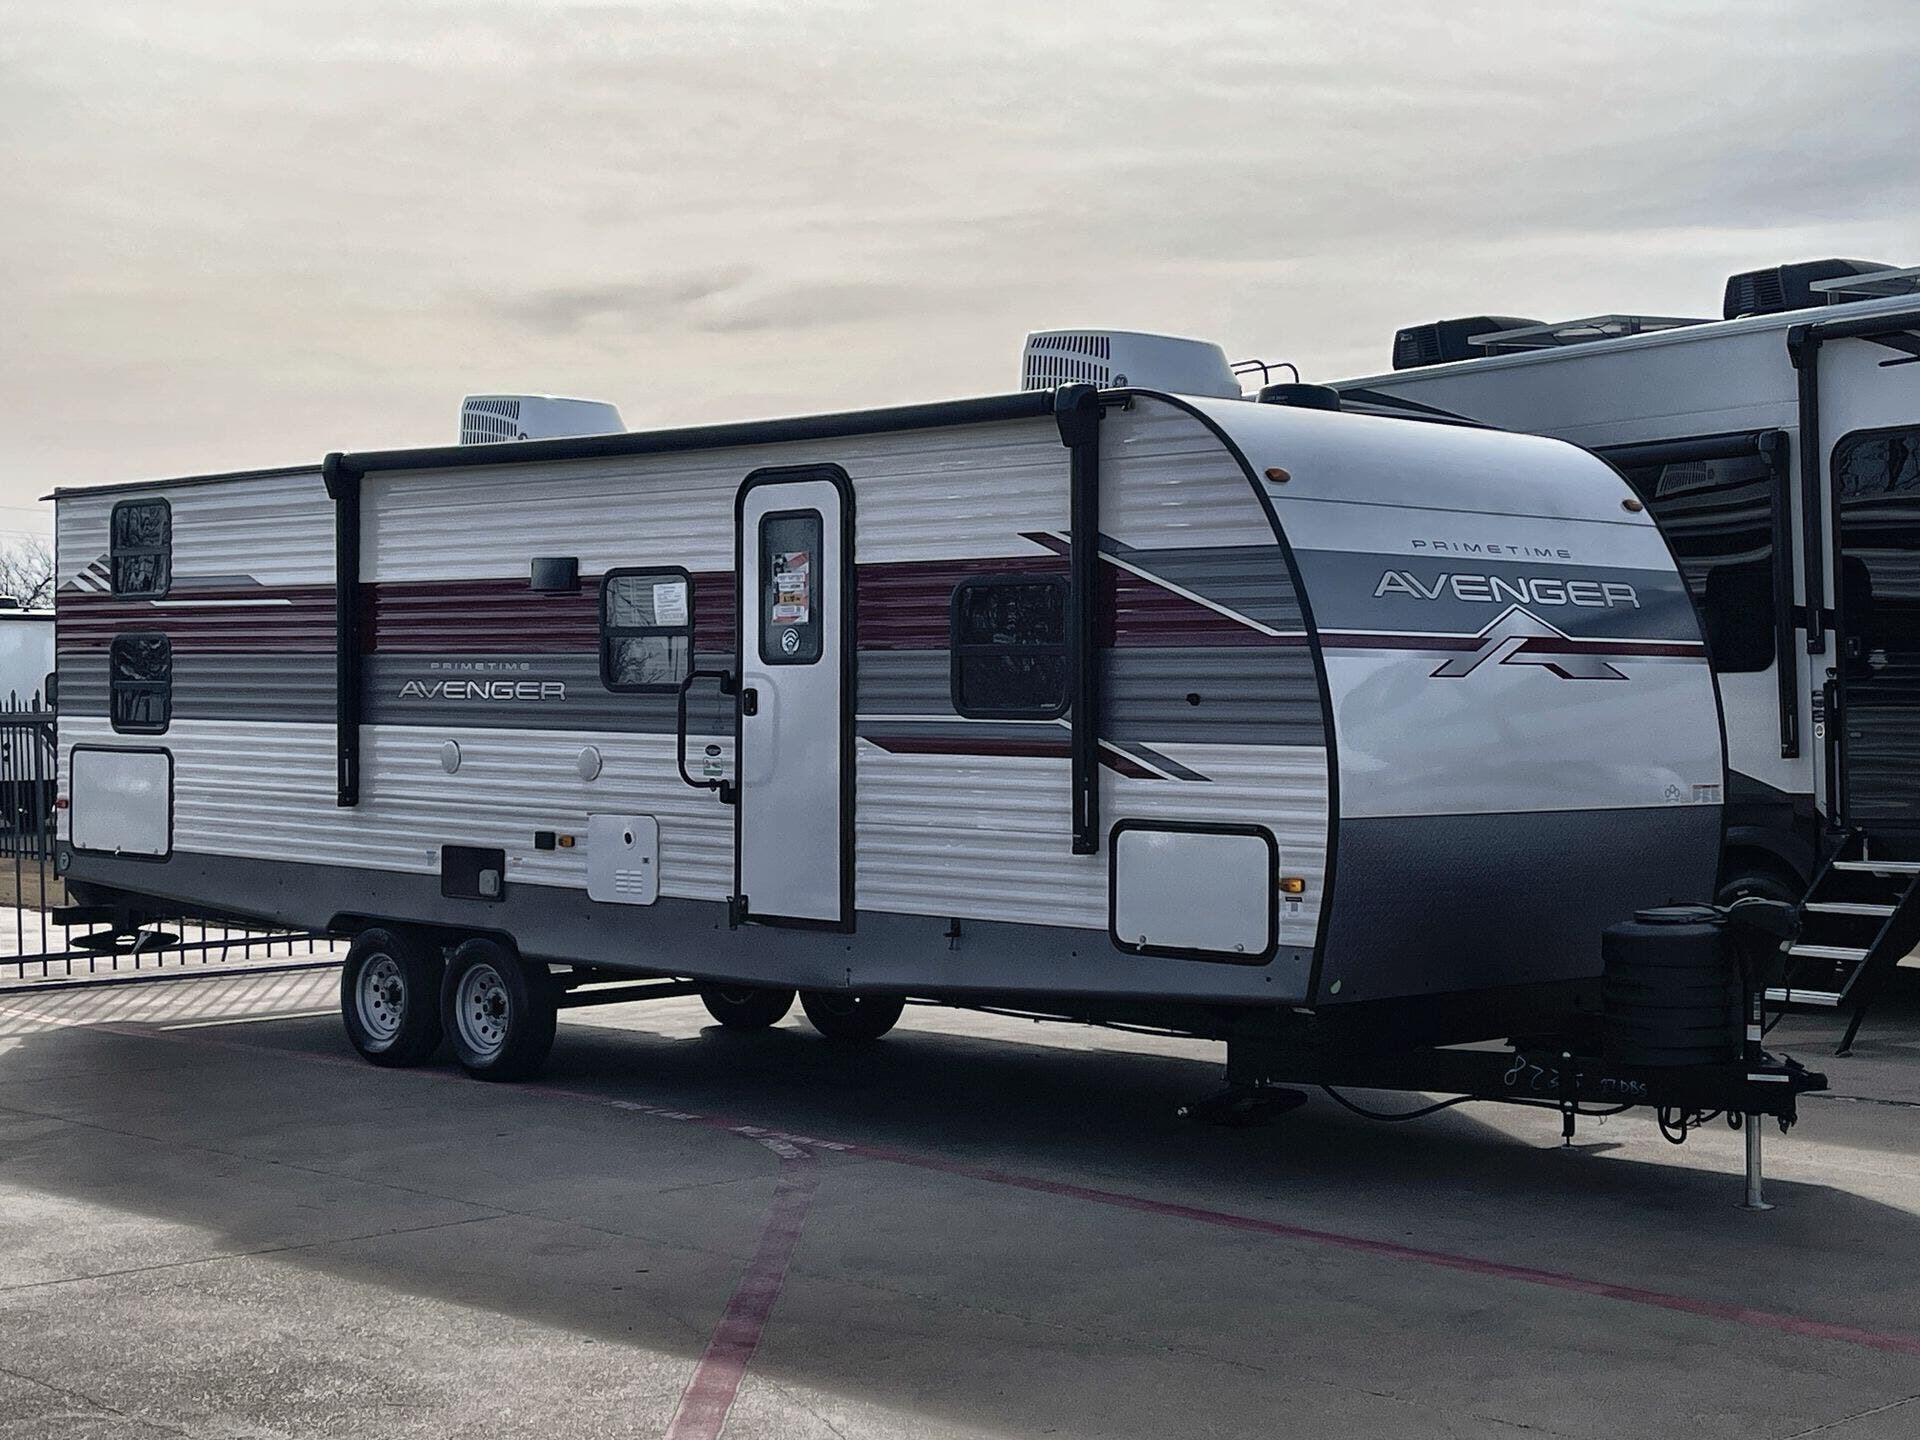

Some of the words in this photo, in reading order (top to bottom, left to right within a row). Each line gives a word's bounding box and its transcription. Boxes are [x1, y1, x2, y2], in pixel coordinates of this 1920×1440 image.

[1411, 539, 1572, 559] PRIMETIME
[1373, 570, 1641, 608] AVENGER
[430, 662, 531, 671] PRIMETIME
[398, 680, 566, 701] AVENGER
